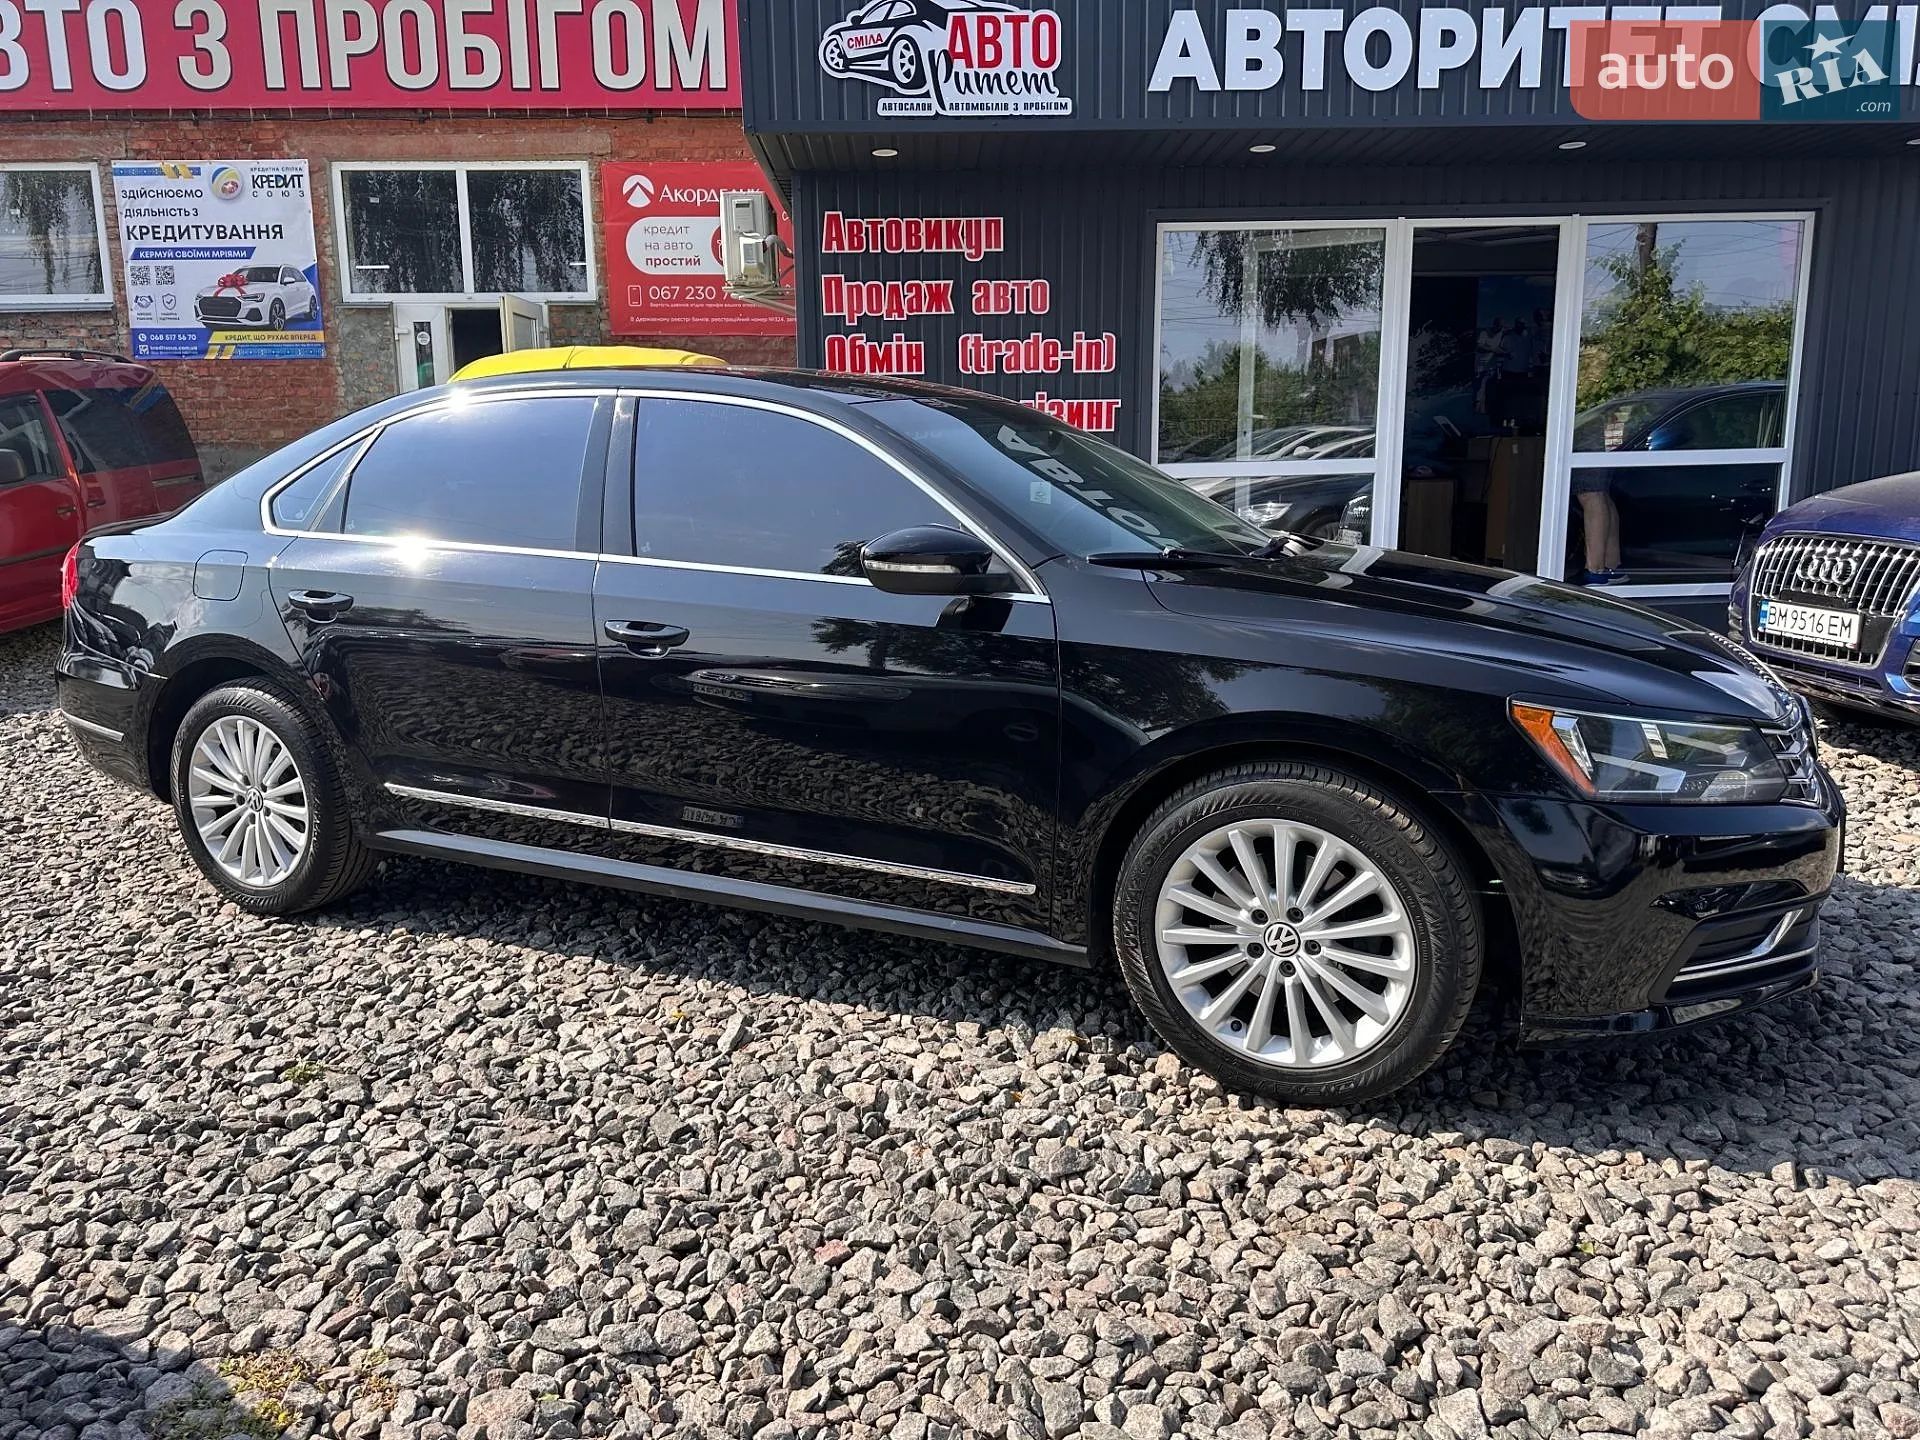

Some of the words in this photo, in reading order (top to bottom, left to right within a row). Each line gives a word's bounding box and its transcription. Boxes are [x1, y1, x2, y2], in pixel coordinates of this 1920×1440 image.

[174, 0, 232, 90] З
[258, 0, 727, 90] ПРОБІГОМ
[847, 33, 883, 49] СМІЛА
[948, 14, 1057, 69] АВТО
[1148, 6, 1722, 91] АВТОРИТЕТ
[1747, 4, 1920, 88] СМІ
[882, 102, 932, 111] АВТОСАЛОН
[949, 102, 1009, 111] АВТОМОБІЛІВ
[1013, 102, 1019, 111] З
[1023, 102, 1068, 111] ПРОБІГОМ
[252, 174, 303, 188] КРЕДИТ
[121, 187, 203, 199] ЗДІЙСНЮЄМО
[124, 207, 190, 218] ДІЯЛЬНІСТЬ
[193, 208, 199, 217] З
[126, 224, 284, 242] КРЕДИТУВАННЯ
[644, 225, 690, 236] кредит
[822, 211, 1003, 261] Автовикуп
[139, 249, 174, 259] КЕРМУЙ
[175, 249, 210, 258] СВОЇМИ
[212, 249, 247, 258] МРІЯМИ
[645, 242, 660, 250] на
[664, 242, 693, 250] авто
[646, 255, 701, 268] простий
[649, 286, 679, 300] 067
[685, 286, 716, 300] 230
[822, 274, 954, 325] Продаж
[972, 279, 1049, 315] авто
[825, 333, 924, 374] Обмін
[959, 332, 1117, 373] (trade-in)
[1020, 392, 1121, 431] ізинг
[1768, 606, 1789, 628] BM
[1790, 610, 1824, 633] 9516
[1828, 615, 1853, 638] EM
